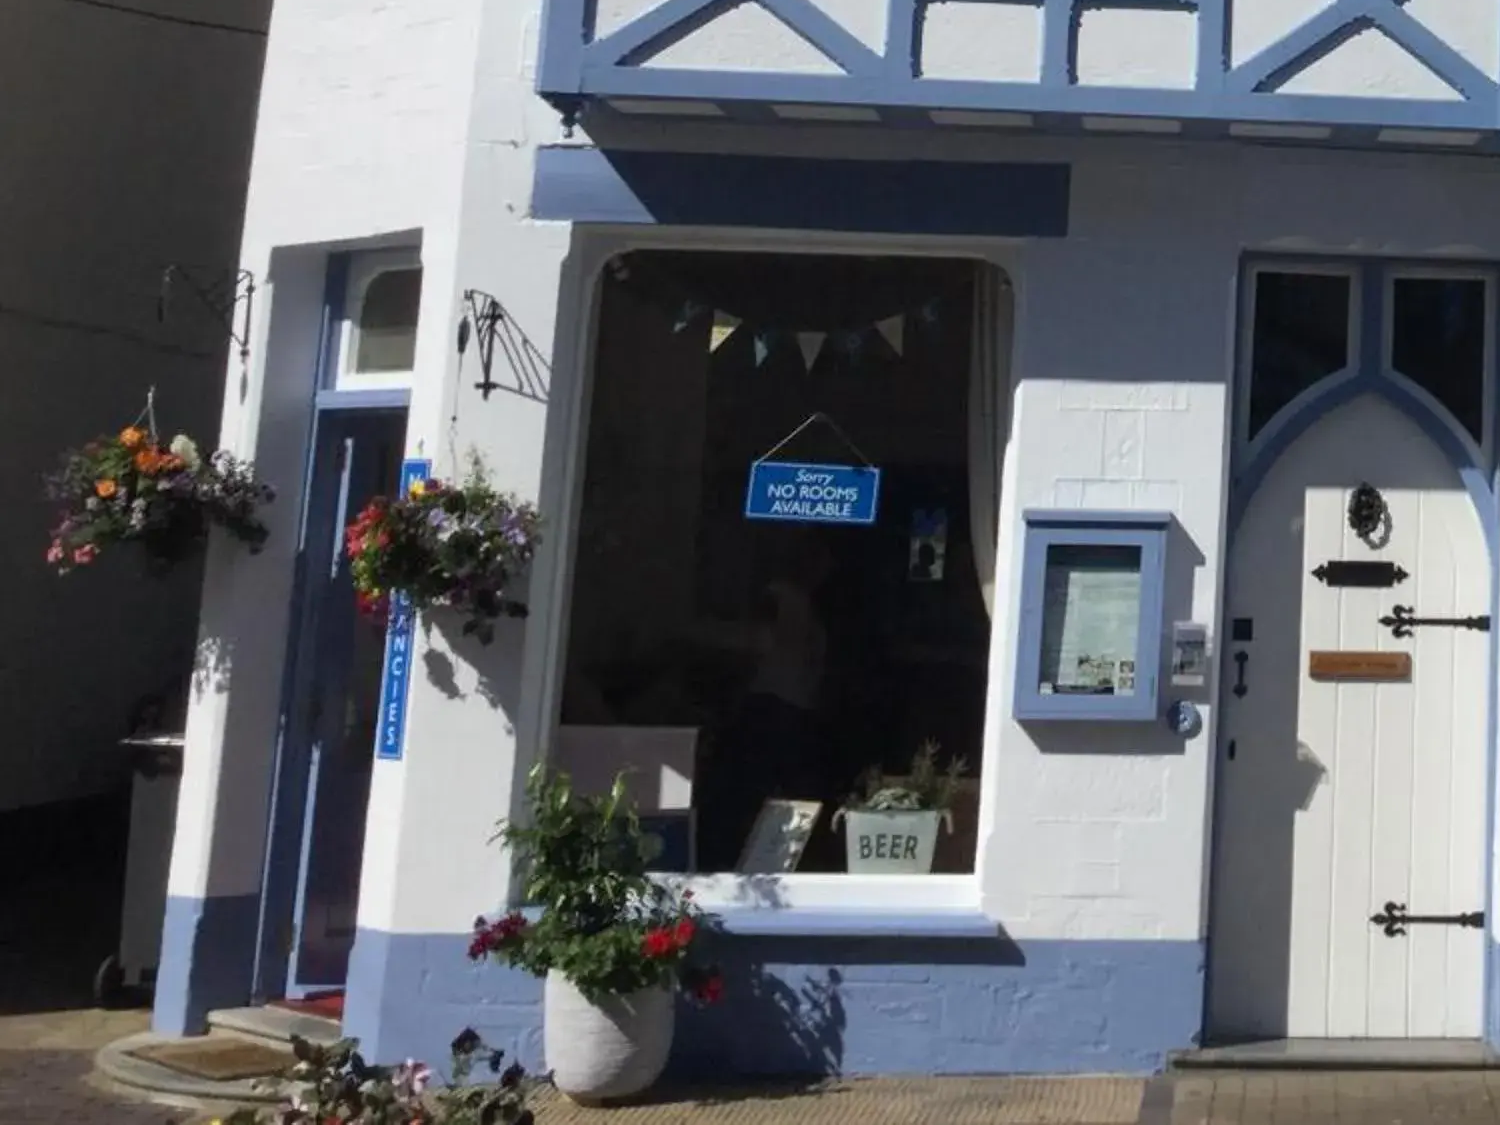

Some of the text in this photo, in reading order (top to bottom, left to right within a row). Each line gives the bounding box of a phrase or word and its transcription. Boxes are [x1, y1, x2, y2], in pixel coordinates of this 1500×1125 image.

[796, 469, 834, 485] Sorry
[767, 484, 859, 502] NO ROOMS
[770, 501, 852, 516] AVAILABLE
[859, 833, 919, 860] BEER
